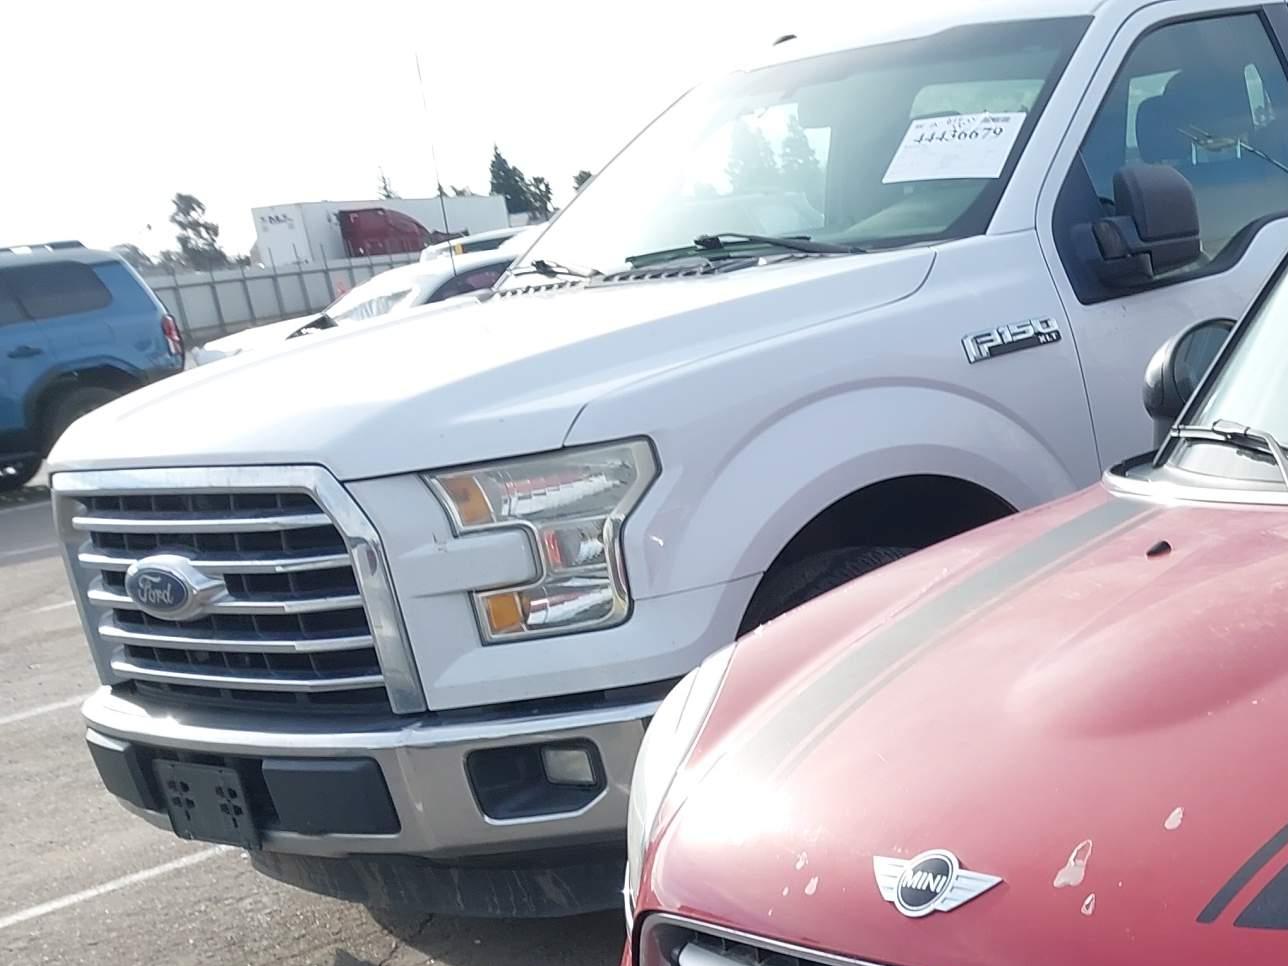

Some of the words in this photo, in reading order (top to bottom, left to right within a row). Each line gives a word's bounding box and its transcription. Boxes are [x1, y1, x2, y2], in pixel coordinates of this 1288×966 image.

[1038, 332, 1058, 344] XLT
[138, 575, 173, 604] Ford
[902, 870, 948, 893] MINI
